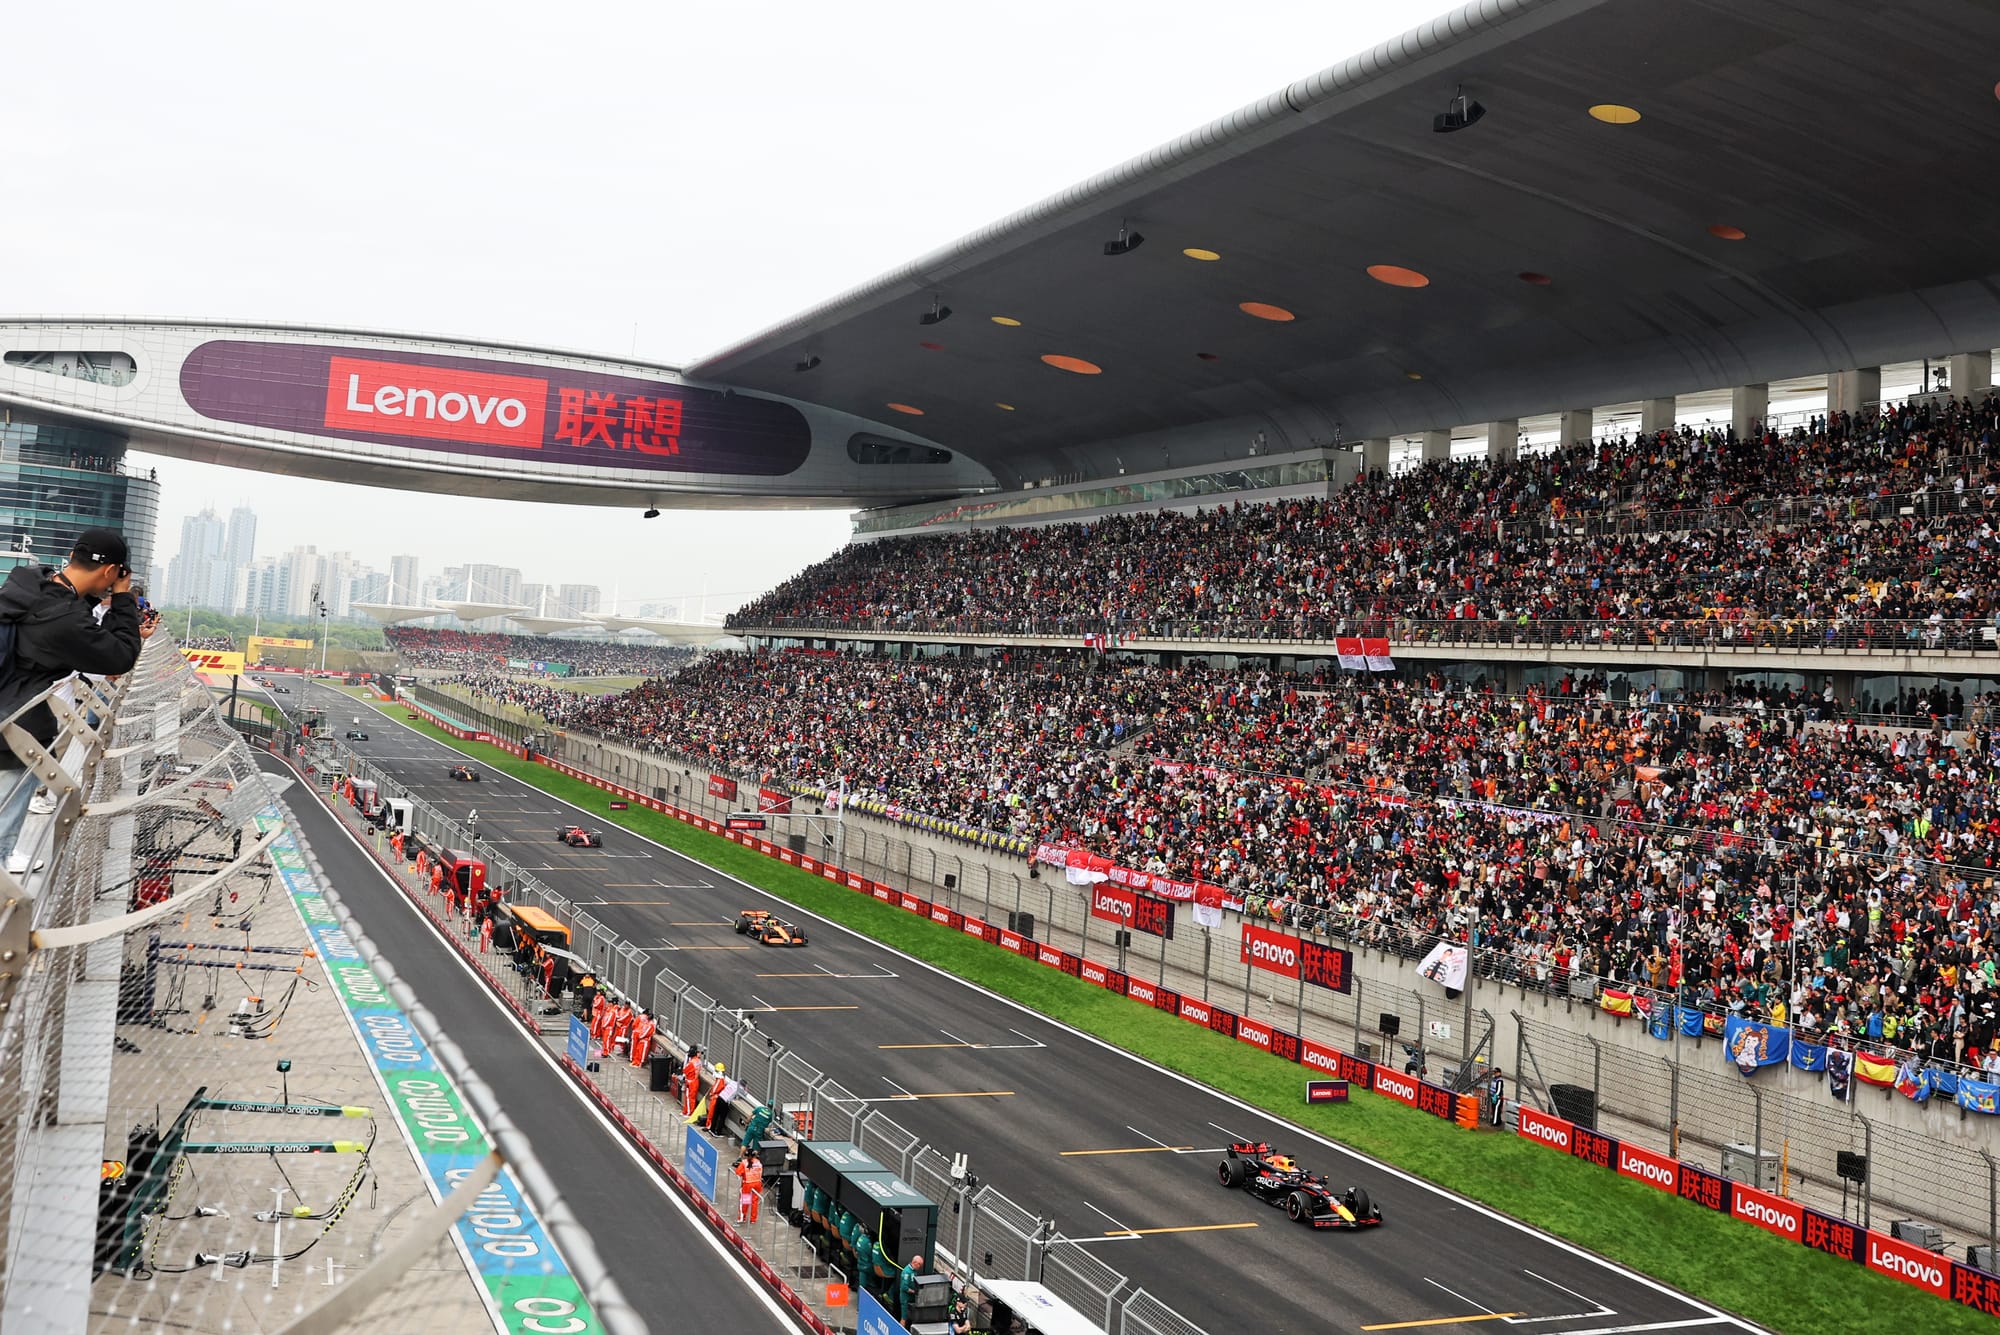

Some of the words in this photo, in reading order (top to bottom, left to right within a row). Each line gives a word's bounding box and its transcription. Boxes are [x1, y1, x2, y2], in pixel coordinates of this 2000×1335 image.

[346, 373, 526, 428] Lenovo
[554, 386, 683, 456] 联想
[1001, 934, 1019, 950] Lenovo
[1039, 948, 1060, 966] Lenovo
[1245, 932, 1295, 967] Lenovo
[1082, 964, 1105, 983] Lenovo
[1303, 943, 1343, 989] 联想
[1129, 981, 1154, 1002] Lenovo
[1181, 1001, 1209, 1022] Lenovo
[1239, 1022, 1269, 1046] Lenovo
[1303, 1046, 1337, 1071] Lenovo
[1376, 1072, 1415, 1100] Lenovo
[1420, 1084, 1449, 1118] 联想
[286, 1107, 320, 1115] aramco
[397, 1079, 469, 1142] aramco
[1522, 1114, 1568, 1147] Lenovo
[214, 1145, 240, 1153] ASTON
[241, 1145, 271, 1153] MARTIN
[273, 1144, 310, 1153] aramco
[1575, 1129, 1610, 1168] 联想
[1256, 1176, 1280, 1189] ORACLE
[1621, 1151, 1673, 1186] Lenovo
[1681, 1167, 1722, 1210] 联想
[1736, 1192, 1796, 1232] Lenovo
[1806, 1213, 1854, 1261] 联想
[1871, 1242, 1944, 1288] Lenovo
